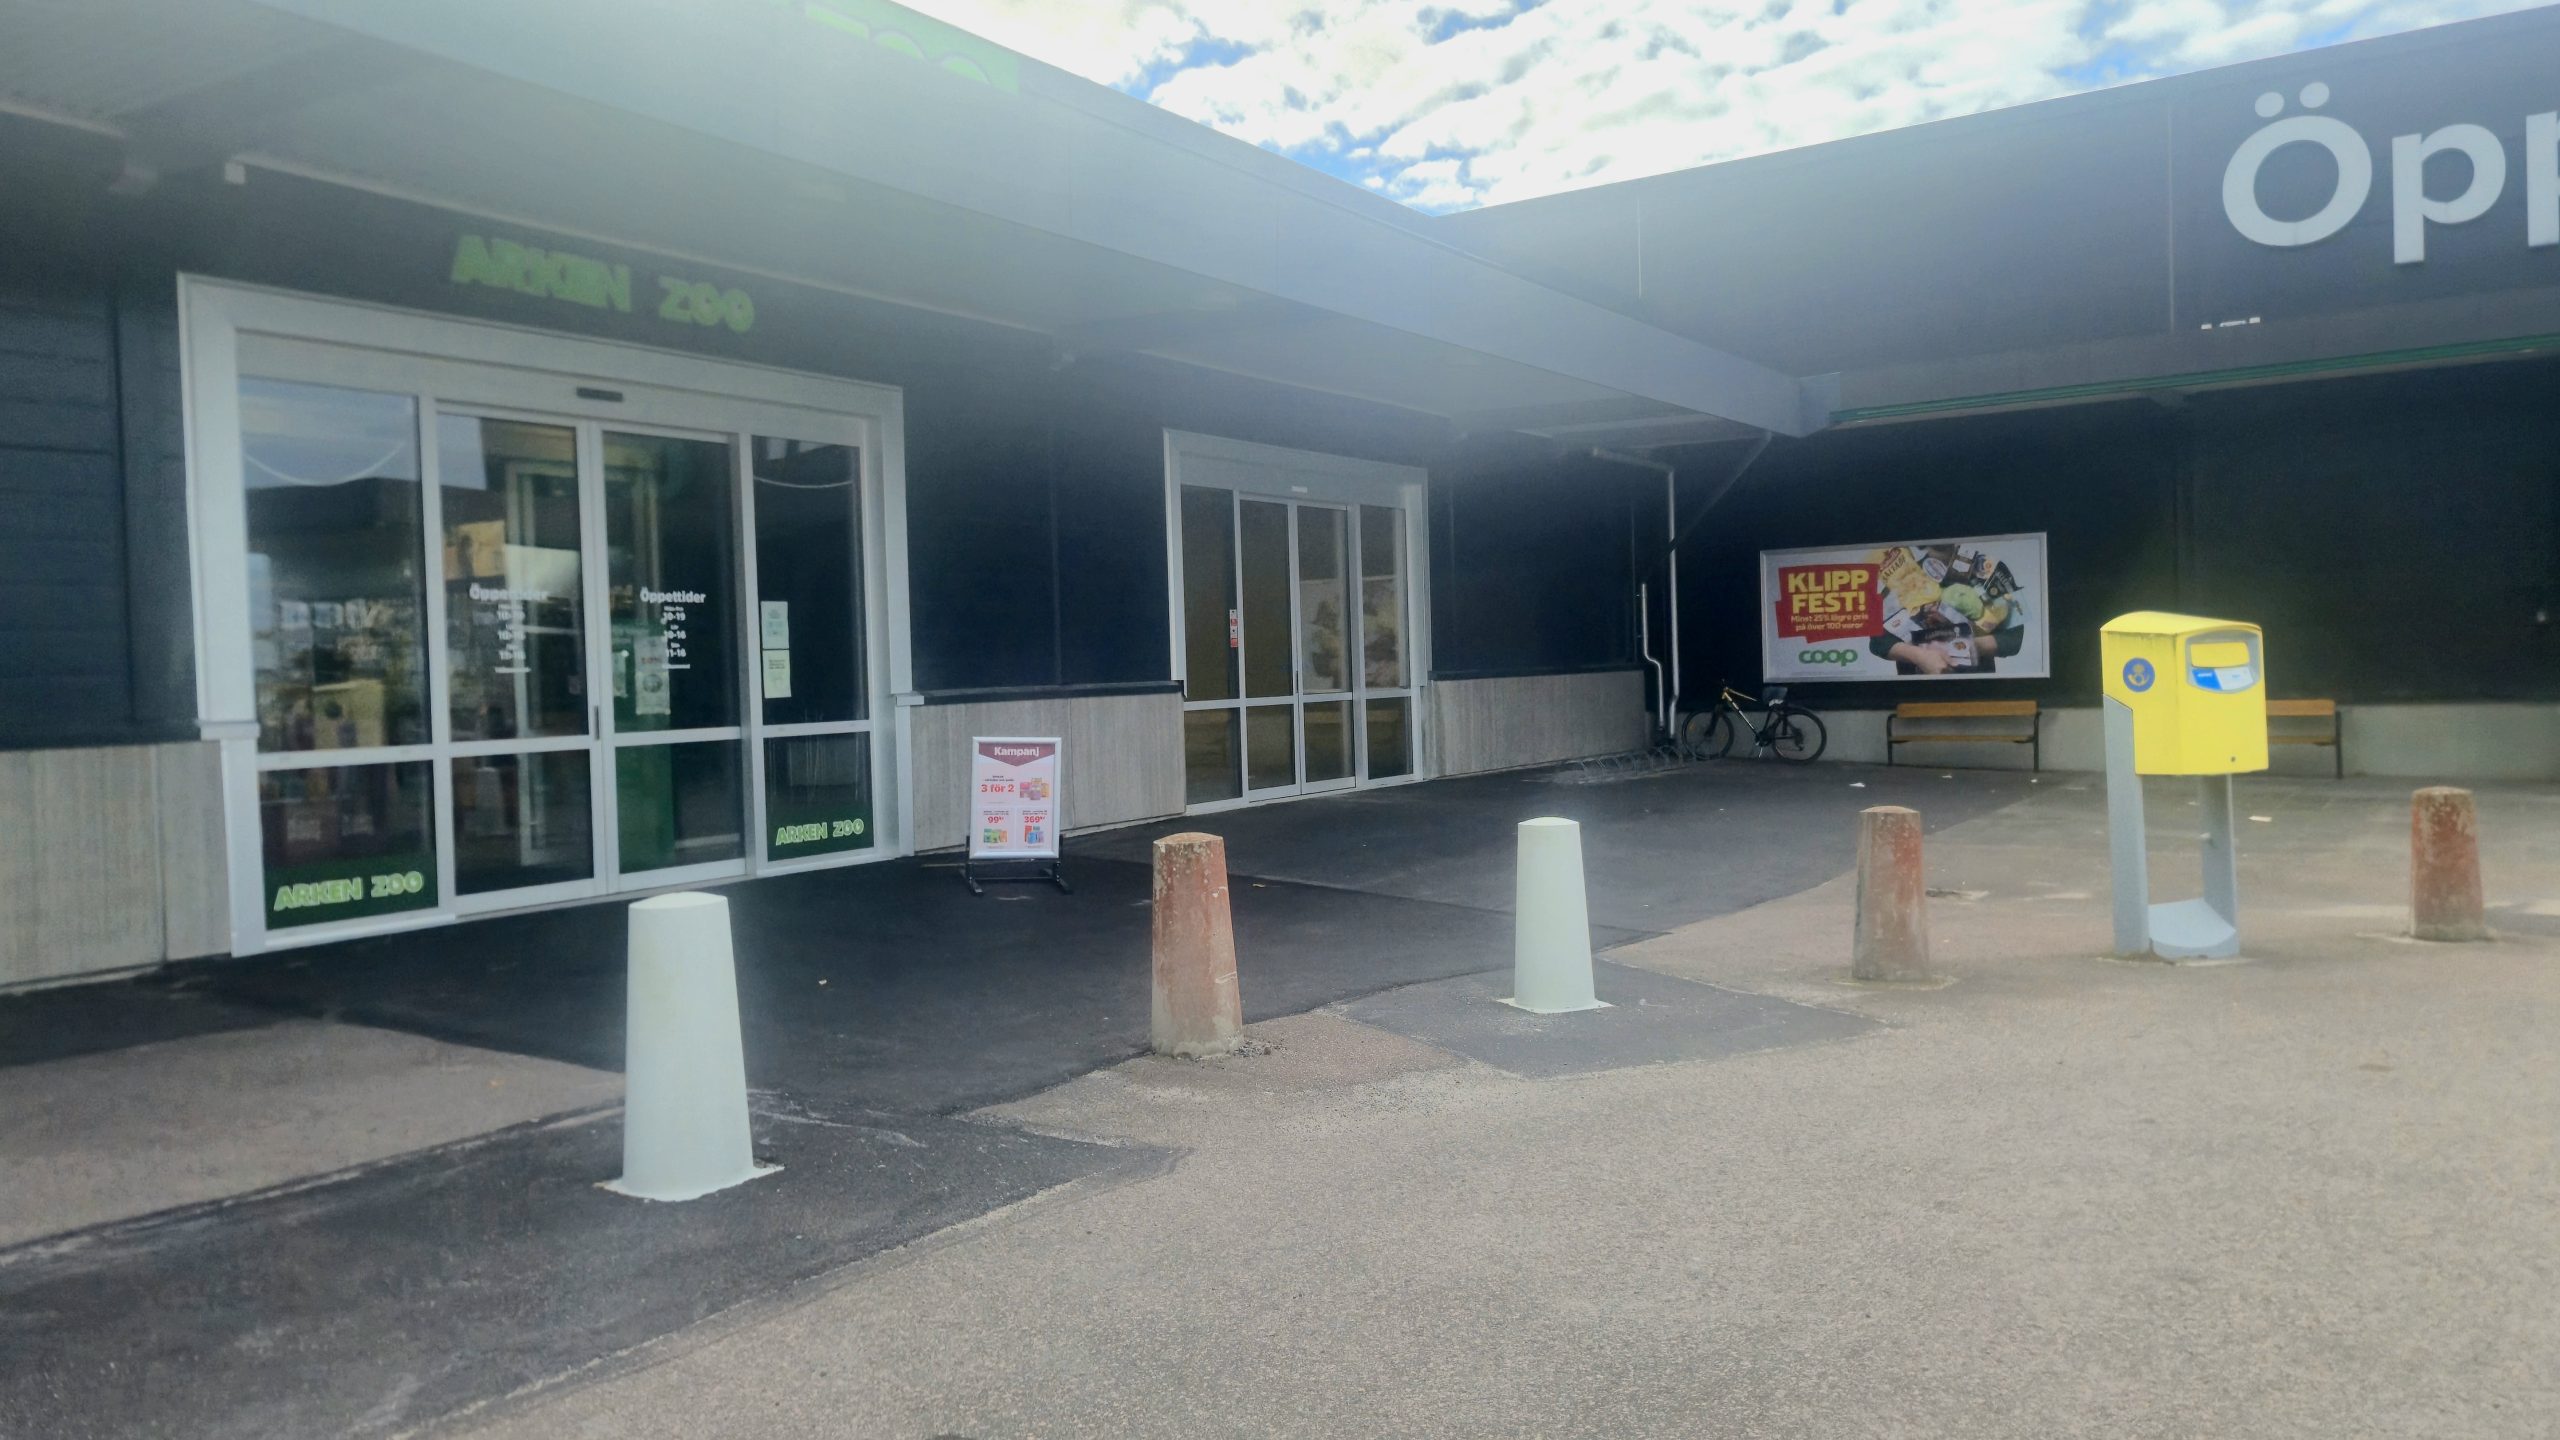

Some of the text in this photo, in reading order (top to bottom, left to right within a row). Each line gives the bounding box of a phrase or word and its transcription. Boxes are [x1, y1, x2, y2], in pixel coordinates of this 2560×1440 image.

[451, 234, 755, 333] ARKEN ZOO
[1788, 569, 1869, 593] KLIPP
[640, 586, 706, 603] Öppettider
[1792, 591, 1866, 614] FEST!
[1827, 622, 1840, 630] 100
[1799, 649, 1858, 667] coop
[994, 746, 1040, 757] Kampanj
[981, 783, 1015, 793] 3 för 2
[776, 818, 864, 846] ARKEN ZOO
[273, 870, 424, 911] ARKEN ZOO
